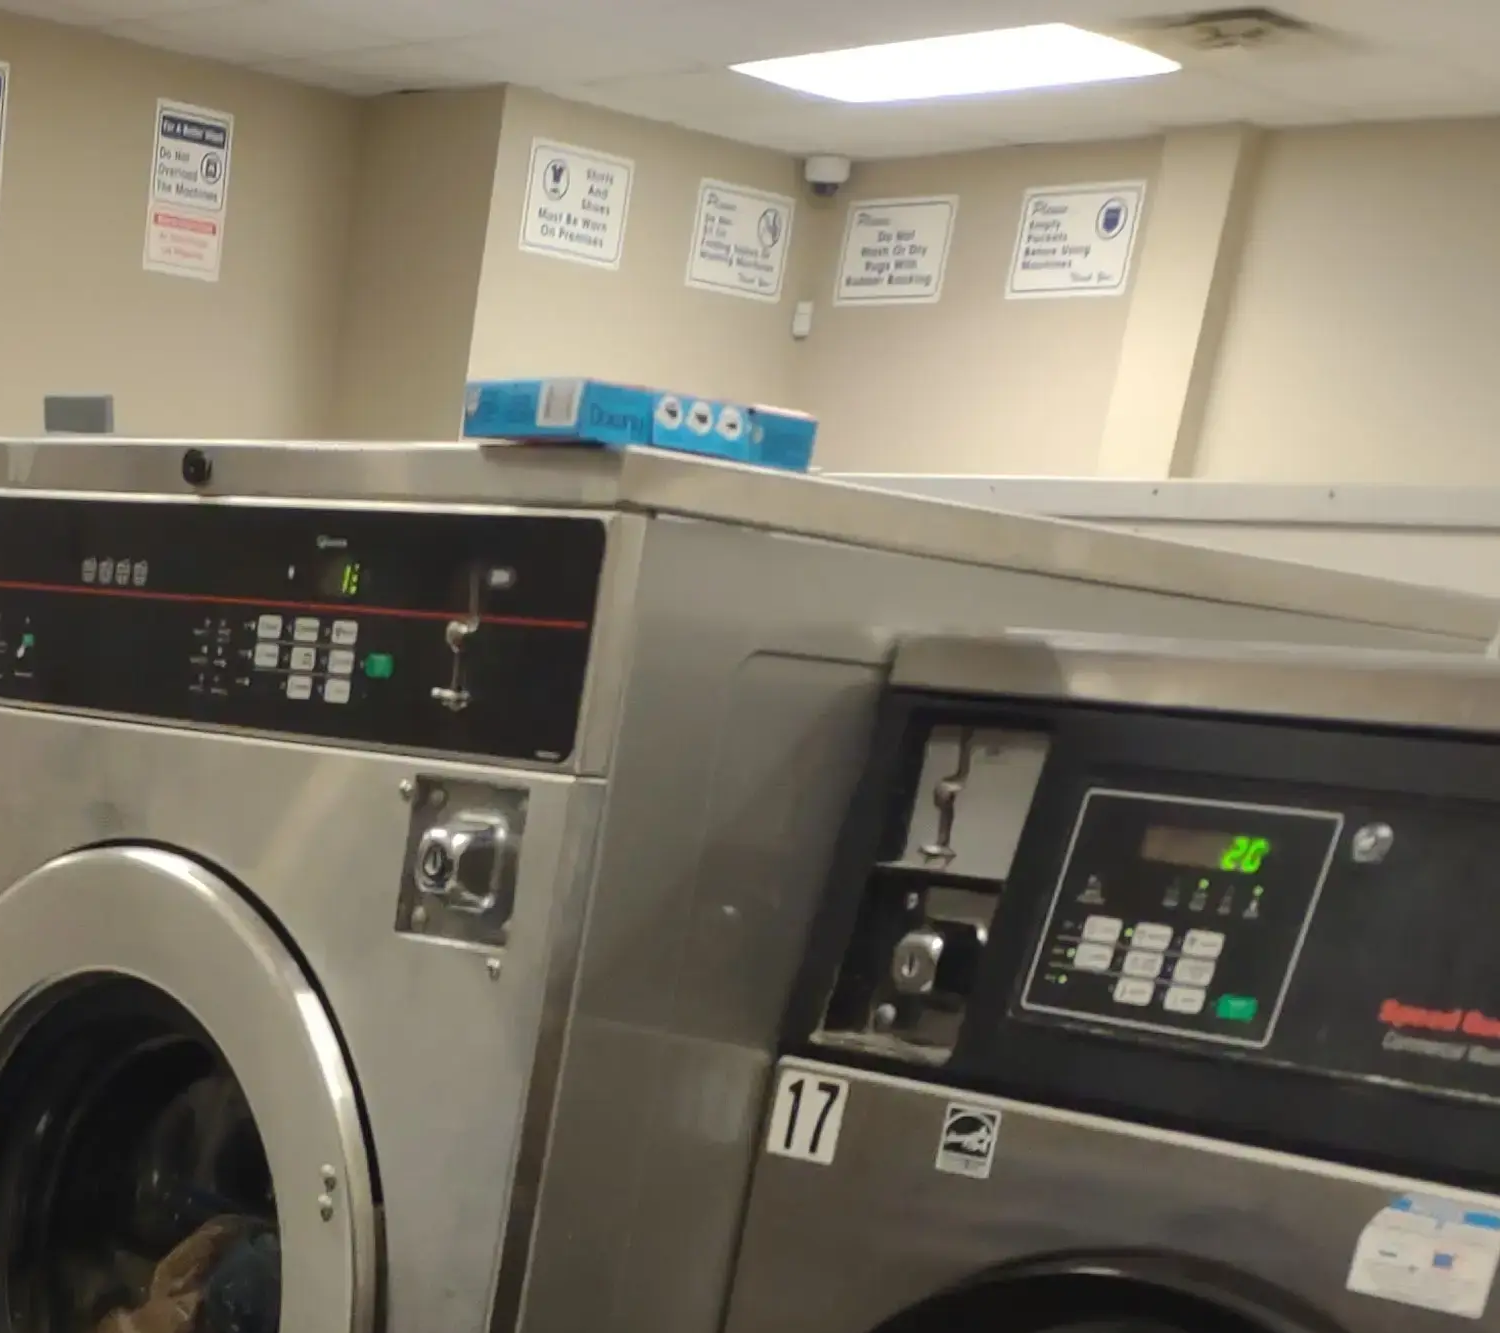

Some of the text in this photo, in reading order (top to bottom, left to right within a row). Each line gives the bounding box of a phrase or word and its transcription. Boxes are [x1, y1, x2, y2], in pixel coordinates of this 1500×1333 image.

[160, 146, 191, 163] Do Not
[159, 162, 199, 183] Overload
[156, 179, 218, 203] The Machines
[587, 184, 609, 200] And
[537, 206, 608, 233] Must Be Worn
[540, 223, 604, 248] On Premises
[783, 1079, 841, 1155] 17
